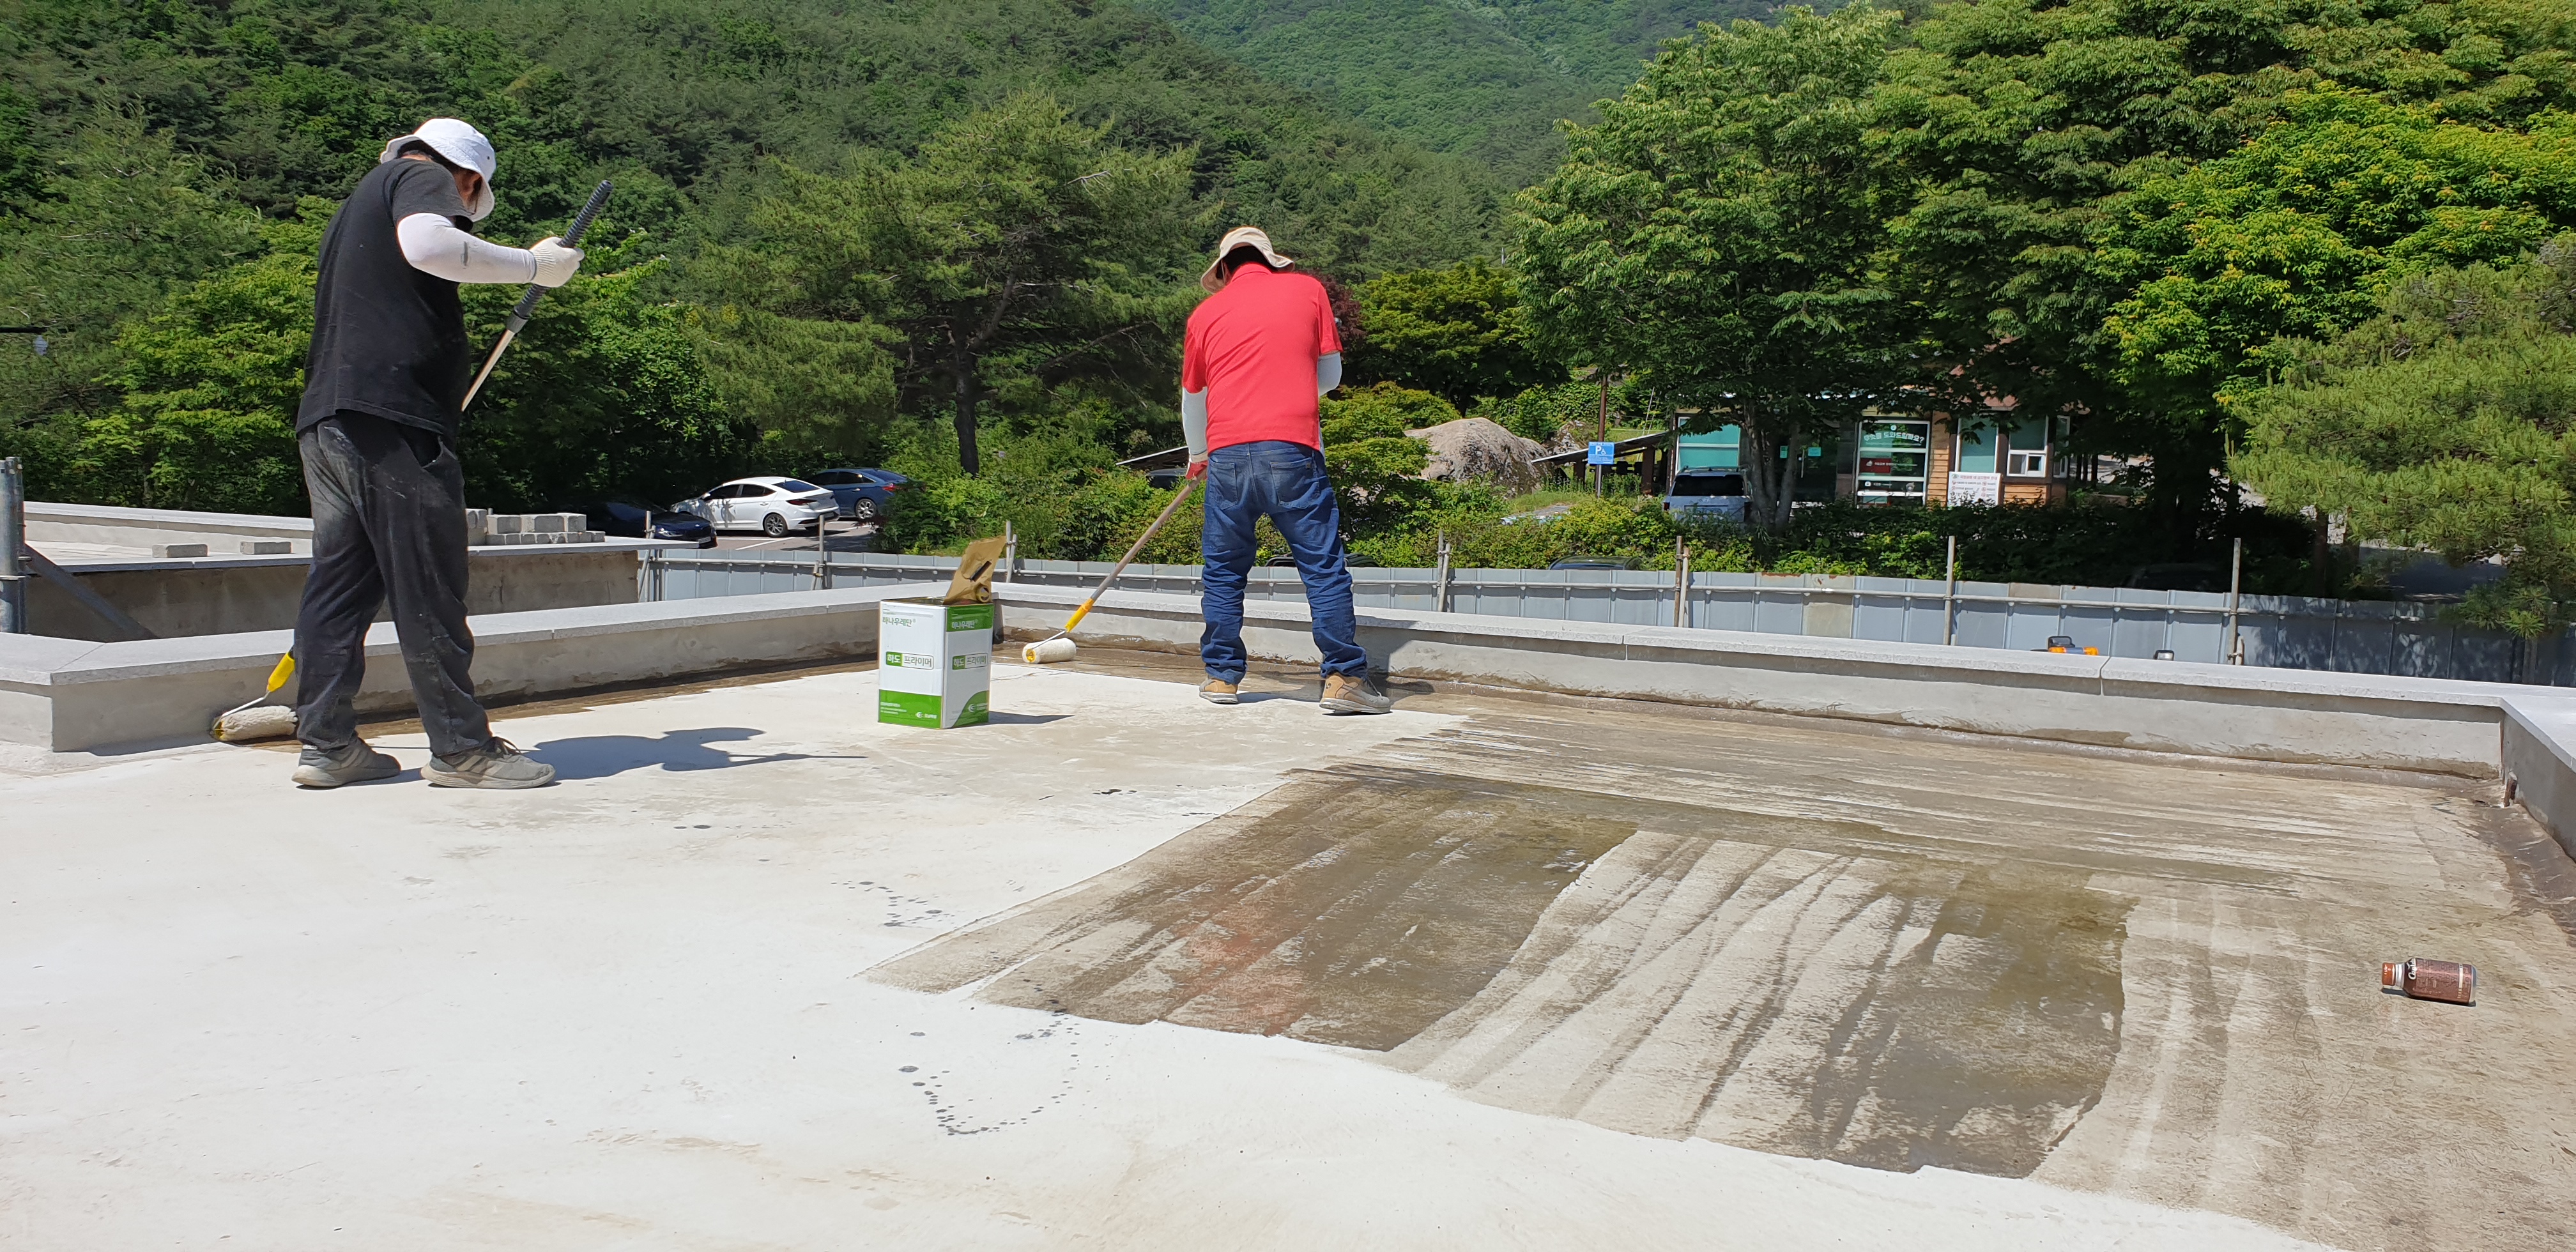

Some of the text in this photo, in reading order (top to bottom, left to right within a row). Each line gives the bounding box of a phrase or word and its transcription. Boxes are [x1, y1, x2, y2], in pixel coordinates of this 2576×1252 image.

[1864, 431, 1924, 443] 무엇을 도와드릴까요?
[1595, 446, 1602, 455] P
[882, 617, 912, 627] 하나우레탄
[887, 654, 931, 667] 하도 프라이머
[954, 655, 986, 667] 하도 프라이머
